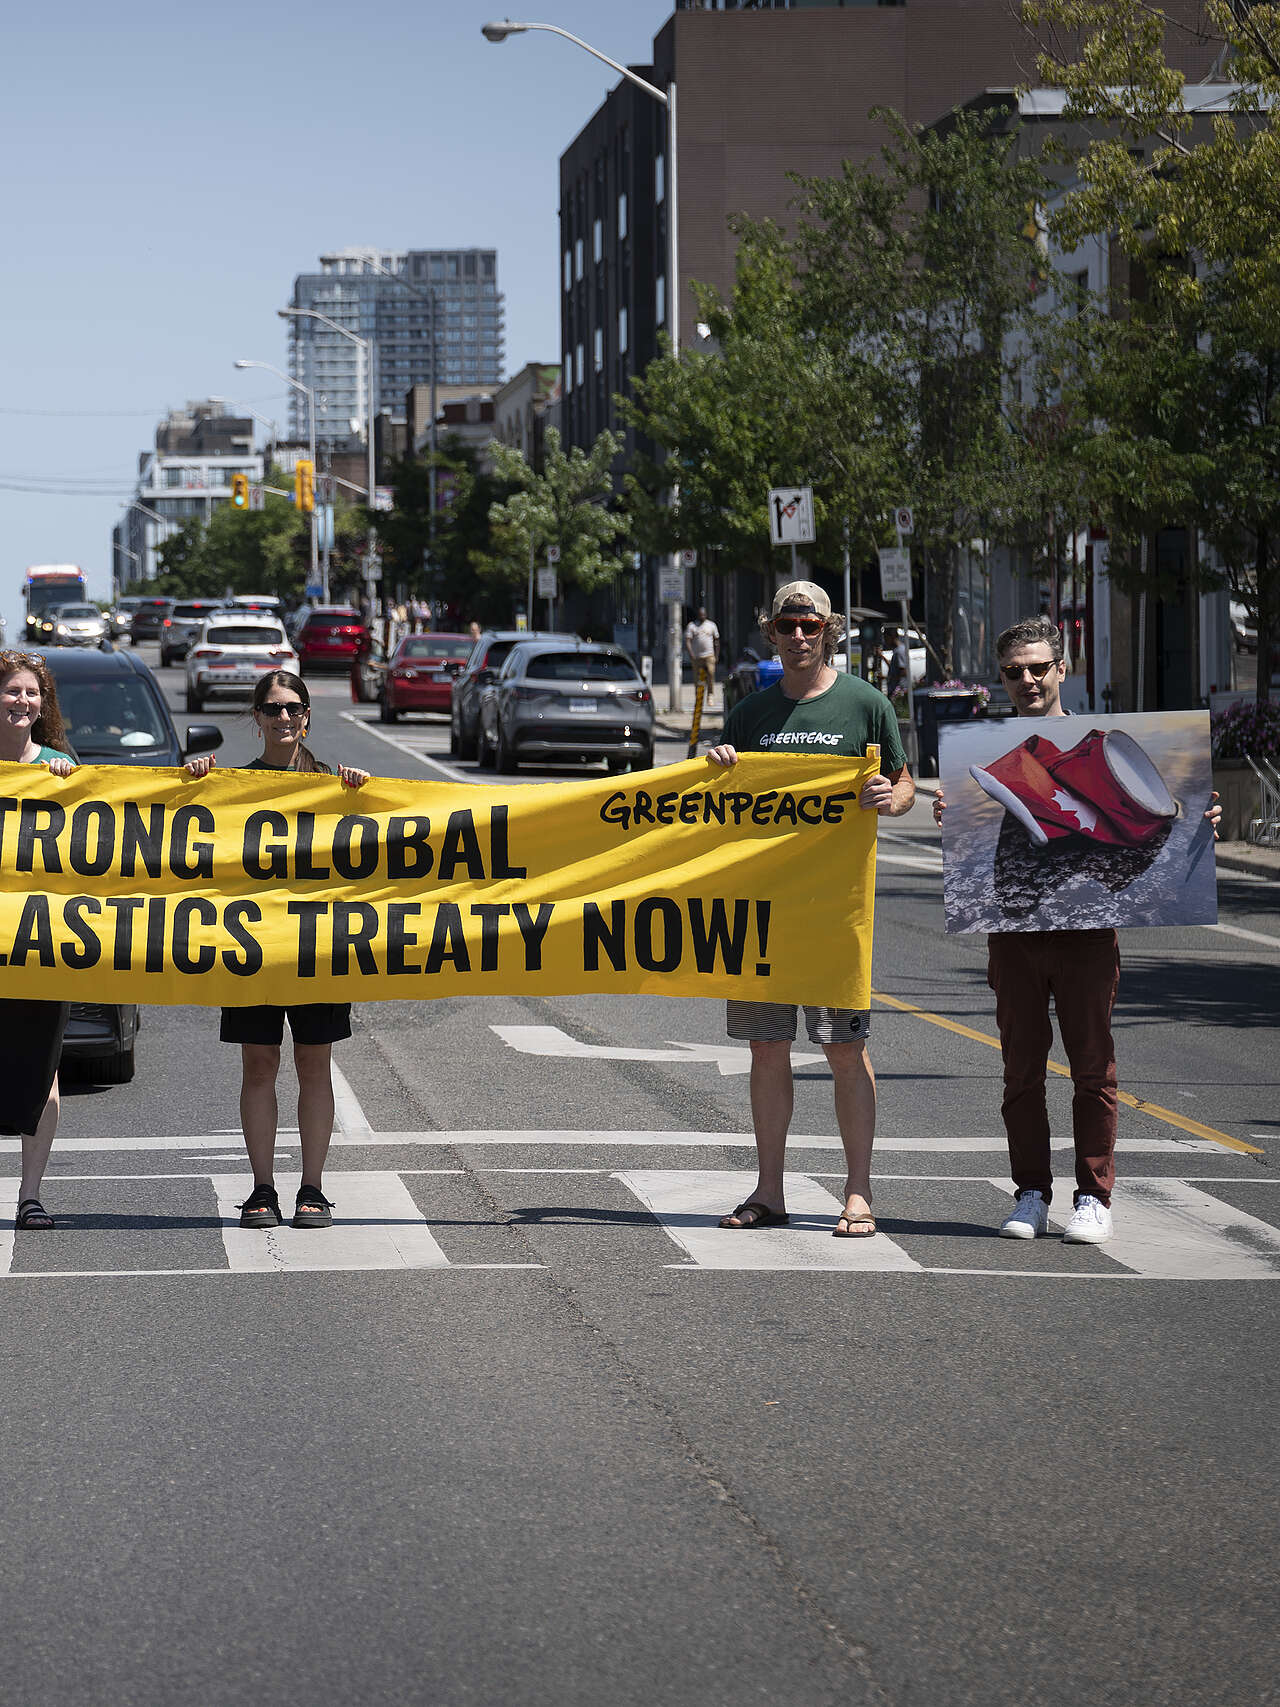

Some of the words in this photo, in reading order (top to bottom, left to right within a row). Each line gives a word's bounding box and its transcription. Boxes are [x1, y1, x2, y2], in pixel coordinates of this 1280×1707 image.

[760, 732, 844, 747] GREENPEACE
[600, 791, 857, 830] GREENPEACE
[242, 805, 527, 880] GLOBAL
[287, 901, 556, 977] TREATY
[583, 897, 771, 976] NOW!
